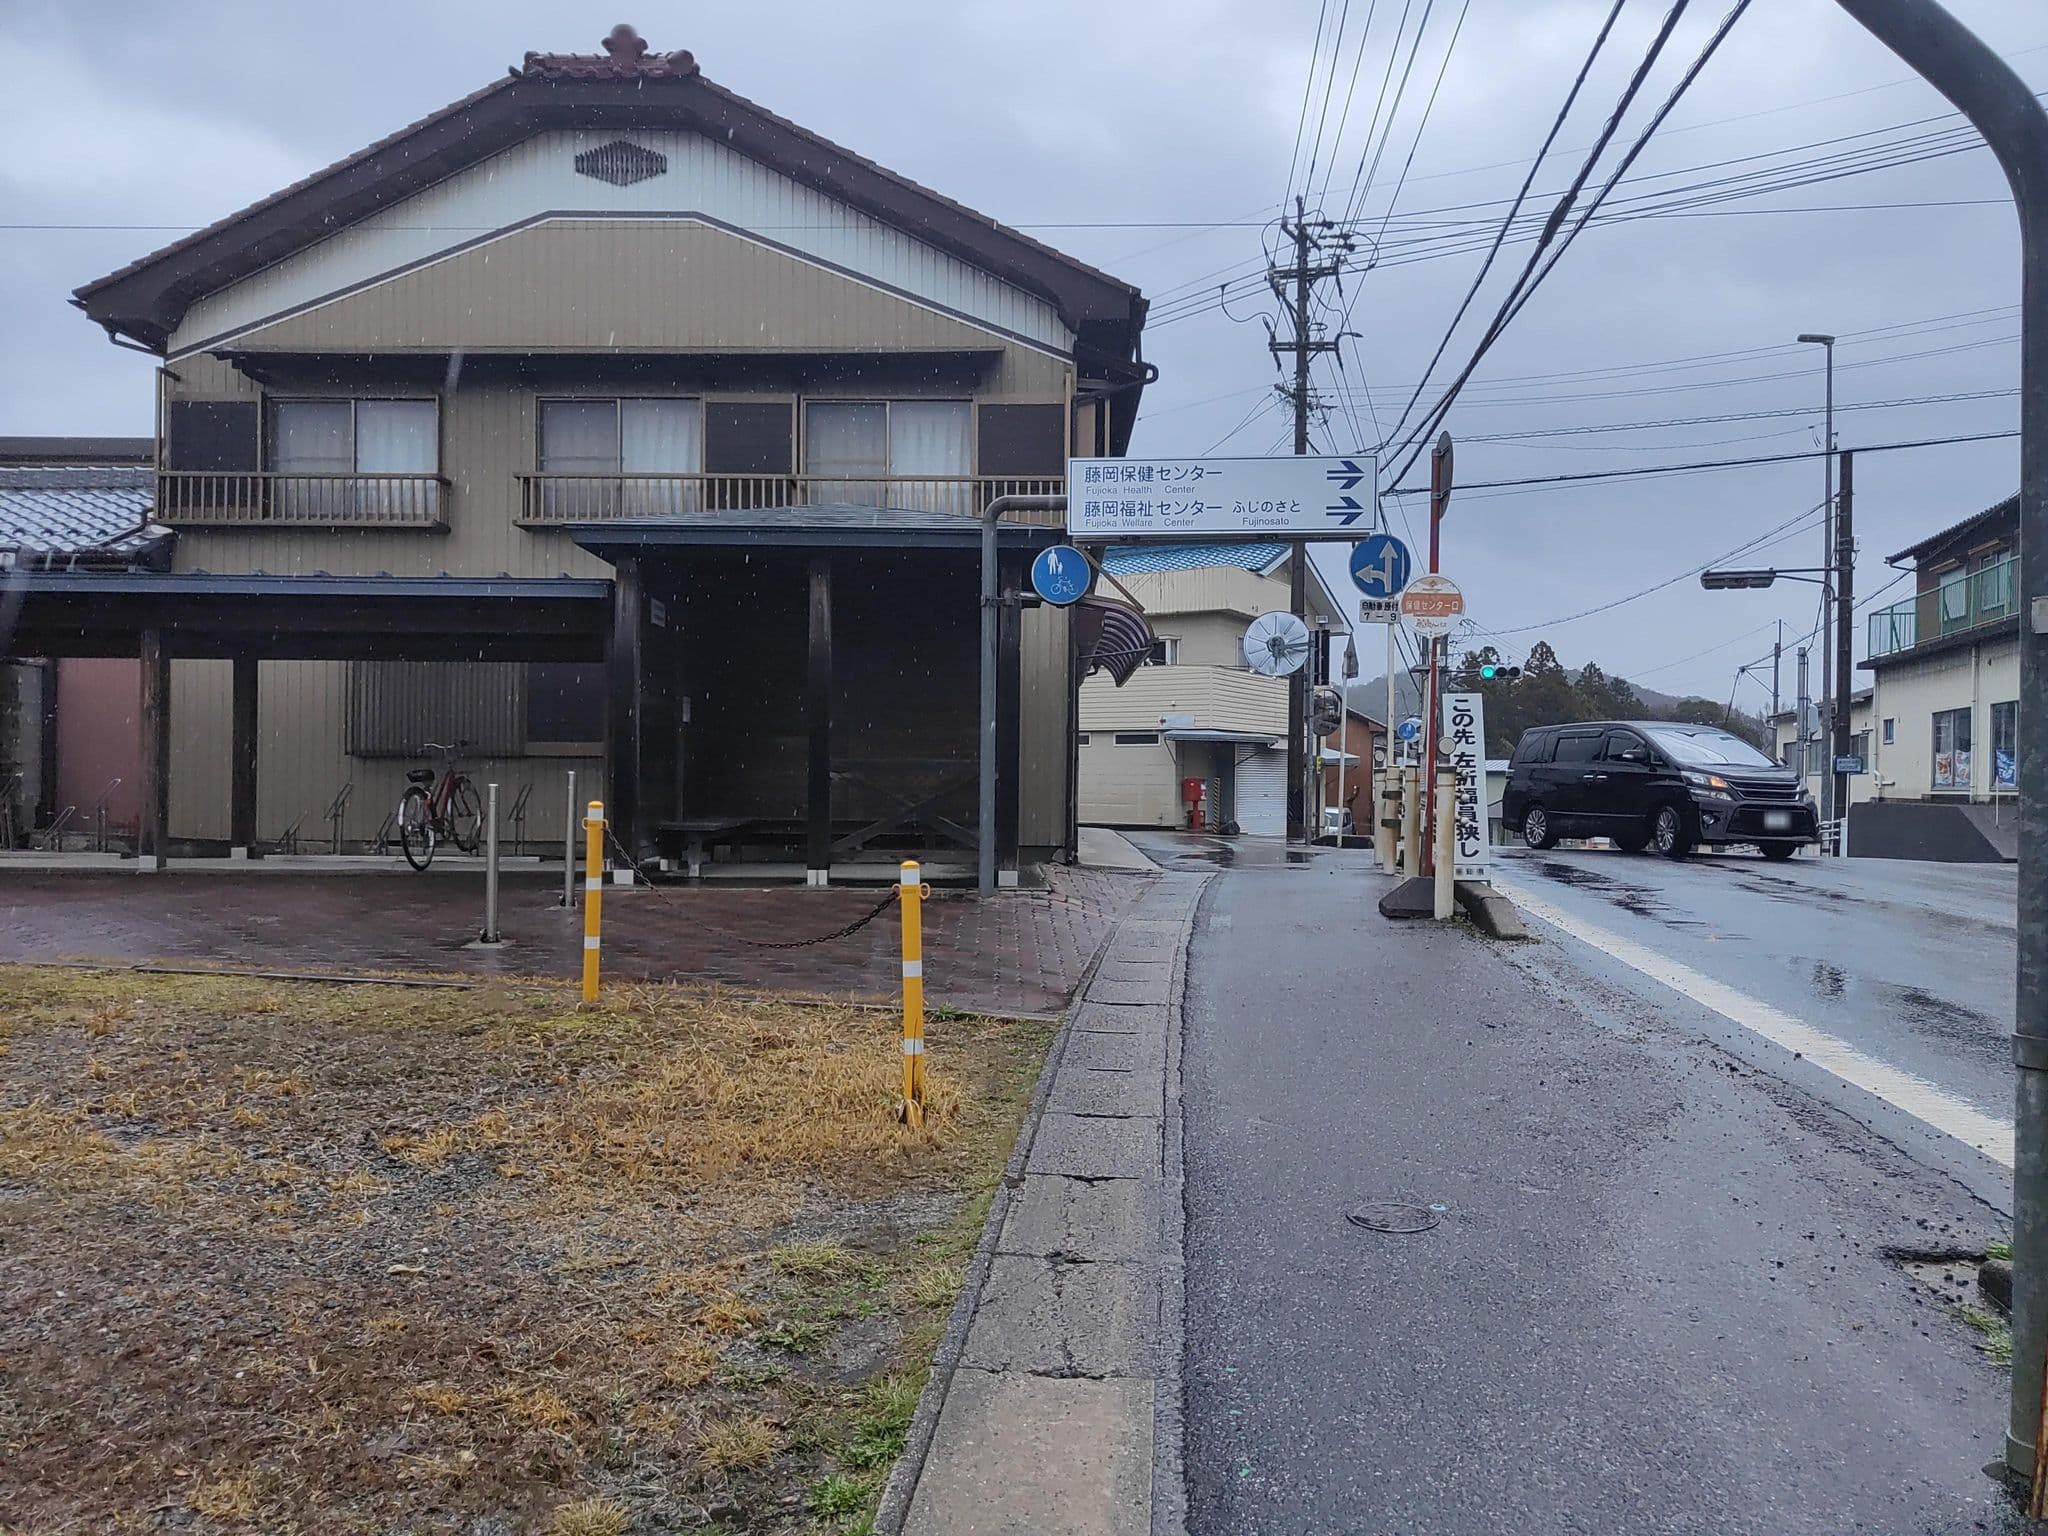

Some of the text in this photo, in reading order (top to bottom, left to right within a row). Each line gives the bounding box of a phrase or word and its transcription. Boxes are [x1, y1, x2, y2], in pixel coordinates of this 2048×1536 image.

[1084, 465, 1223, 483] 藤岡保健センター
[1086, 485, 1196, 495] Fujioka Health Center
[1084, 499, 1302, 517] 藤岡福祉センター ふじのさと
[1085, 517, 1290, 528] Fujioka Welfare Center Fujinosato
